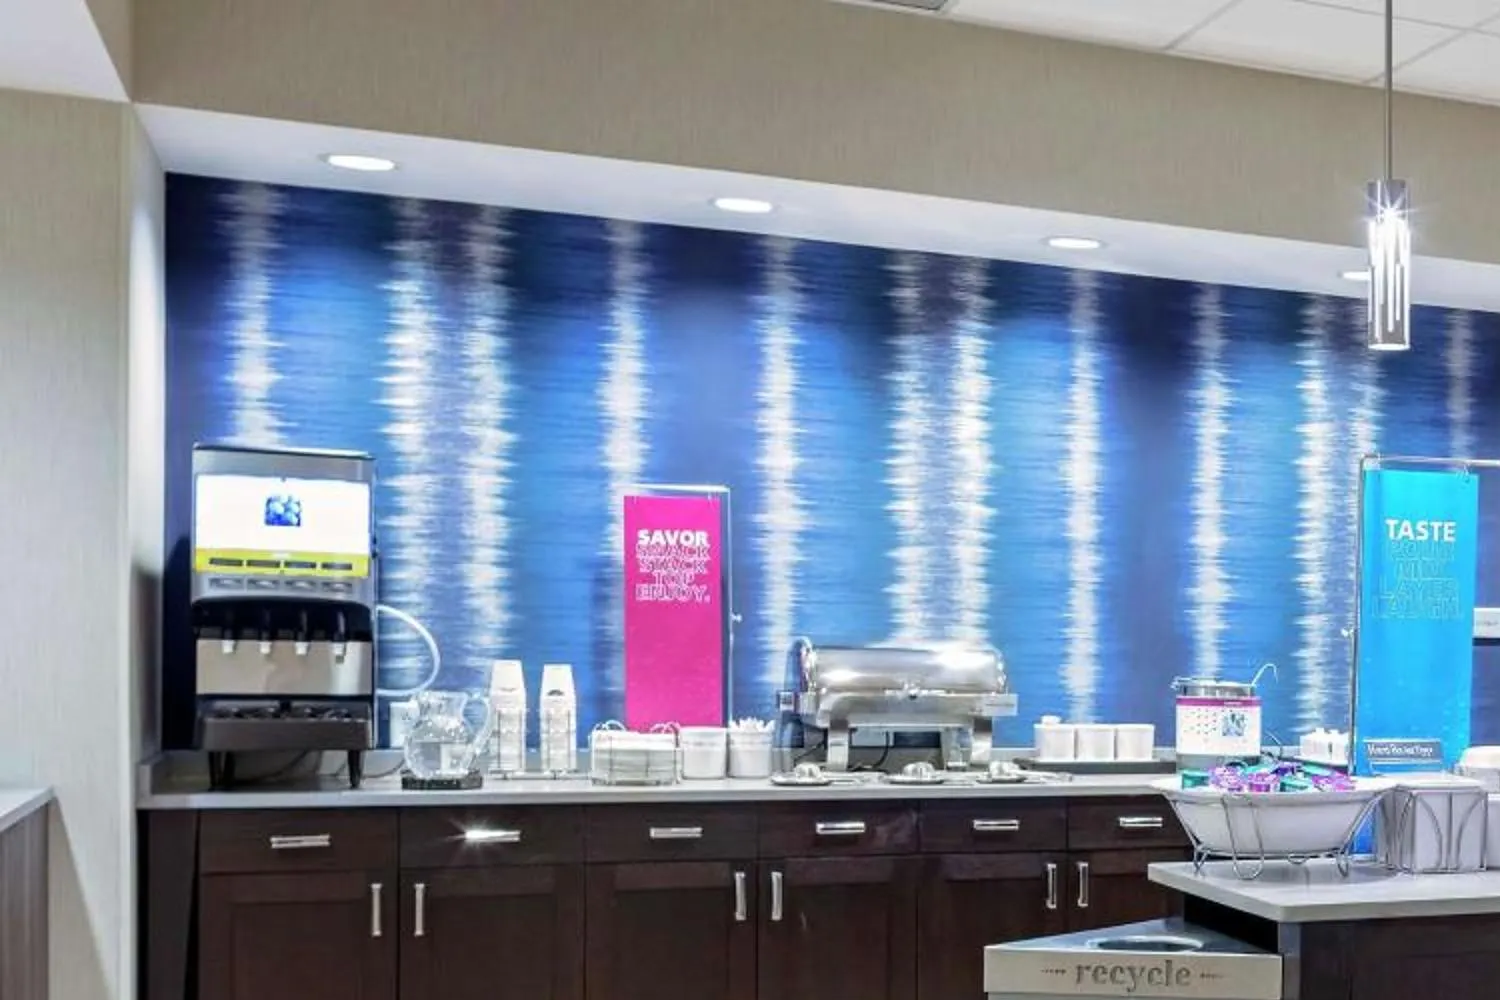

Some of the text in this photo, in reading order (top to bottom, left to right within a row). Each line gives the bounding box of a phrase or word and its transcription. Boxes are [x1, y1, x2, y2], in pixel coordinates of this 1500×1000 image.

[637, 529, 708, 546] SAVOR
[1385, 518, 1457, 543] TASTE
[1075, 958, 1191, 993] recycle
